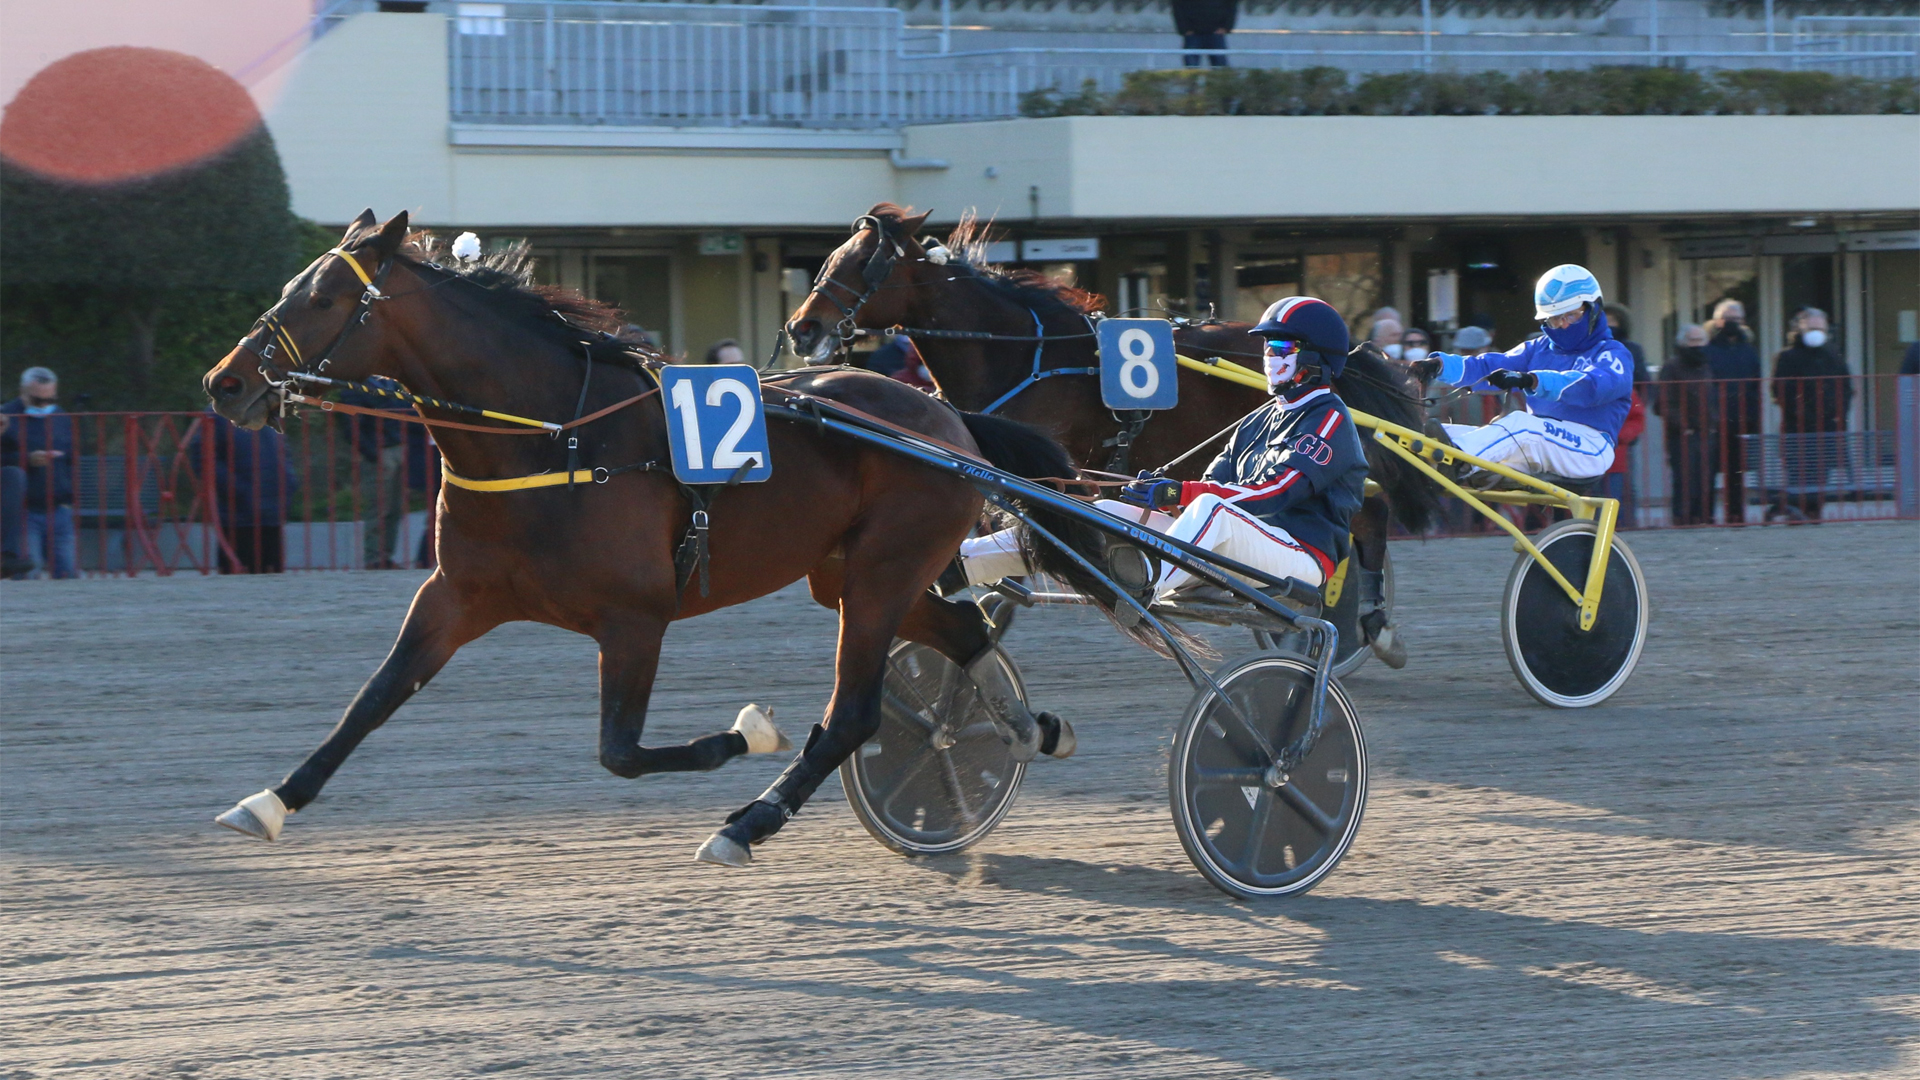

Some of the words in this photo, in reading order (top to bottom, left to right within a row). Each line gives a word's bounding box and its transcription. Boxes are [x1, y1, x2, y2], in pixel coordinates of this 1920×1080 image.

[1118, 328, 1159, 399] 8
[671, 378, 764, 470] 12
[1294, 433, 1333, 466] GD
[1130, 527, 1183, 559] CUSTOM
